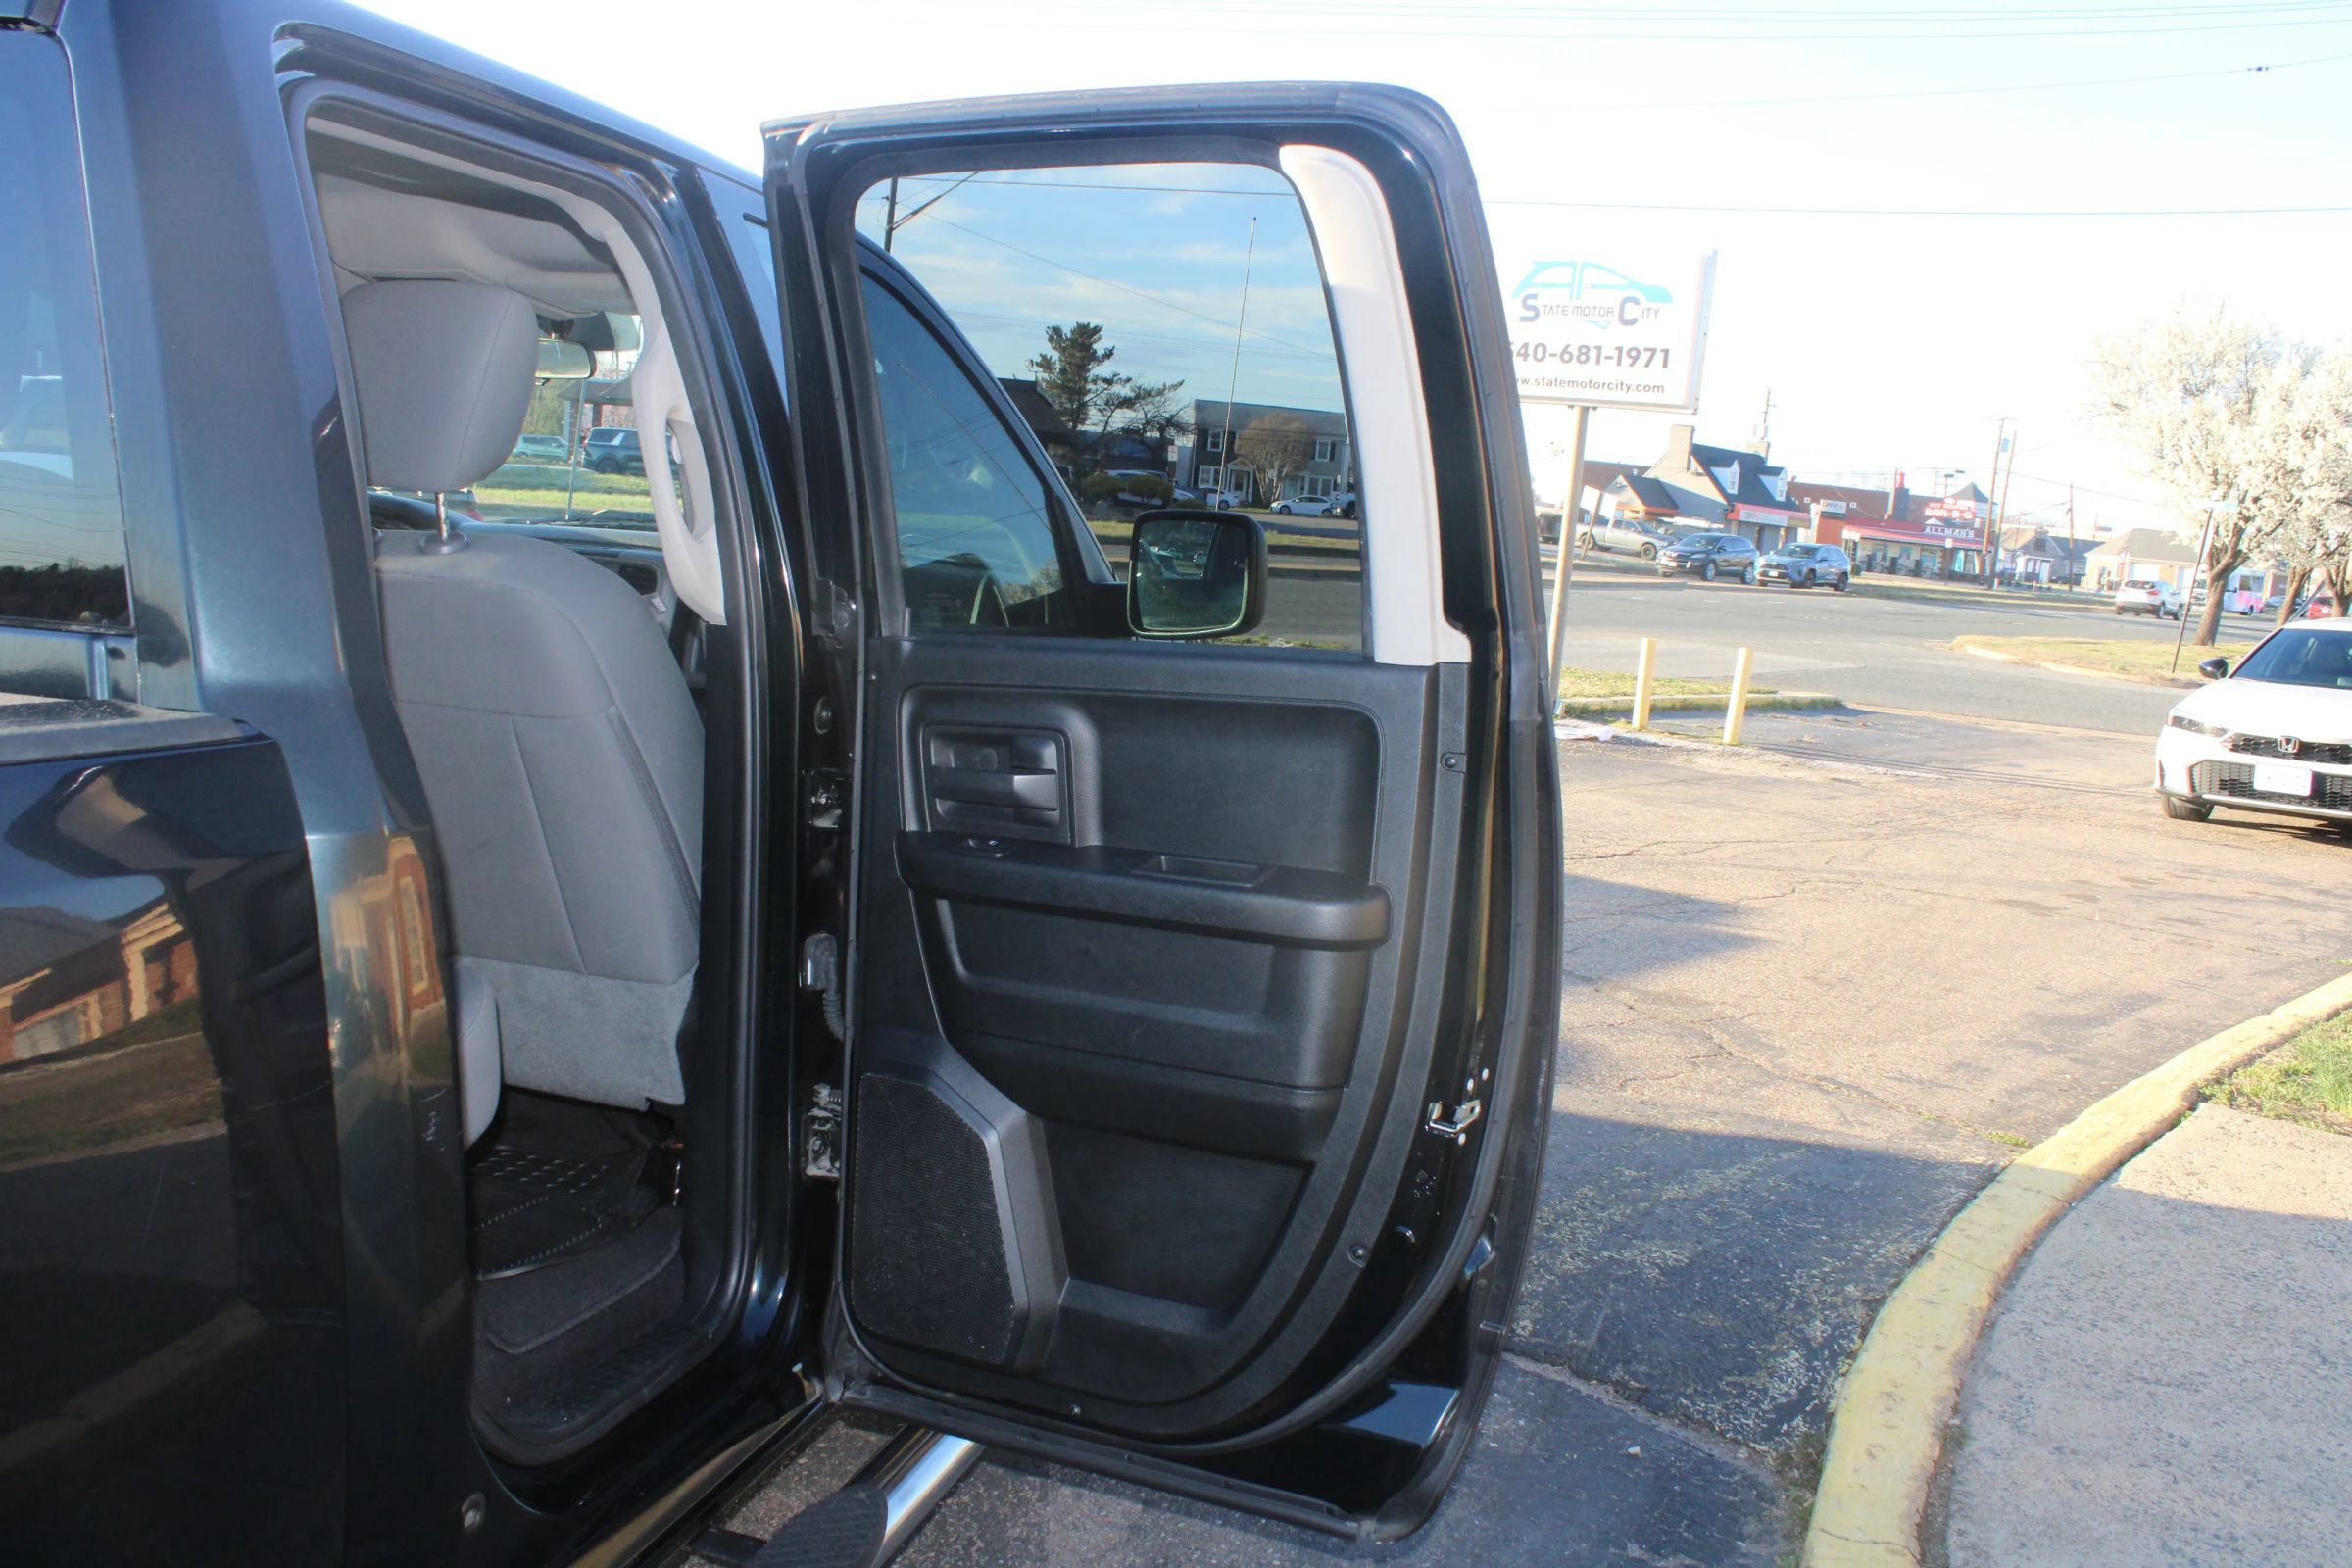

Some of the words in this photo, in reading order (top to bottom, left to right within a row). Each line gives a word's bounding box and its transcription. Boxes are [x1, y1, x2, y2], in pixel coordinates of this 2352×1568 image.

[1519, 293, 1569, 322] STATE
[1572, 305, 1615, 318] MOTOR
[1618, 296, 1660, 326] CITY
[1509, 341, 1670, 369] 40-681-1971
[1924, 507, 1973, 519] BAR-B-Q
